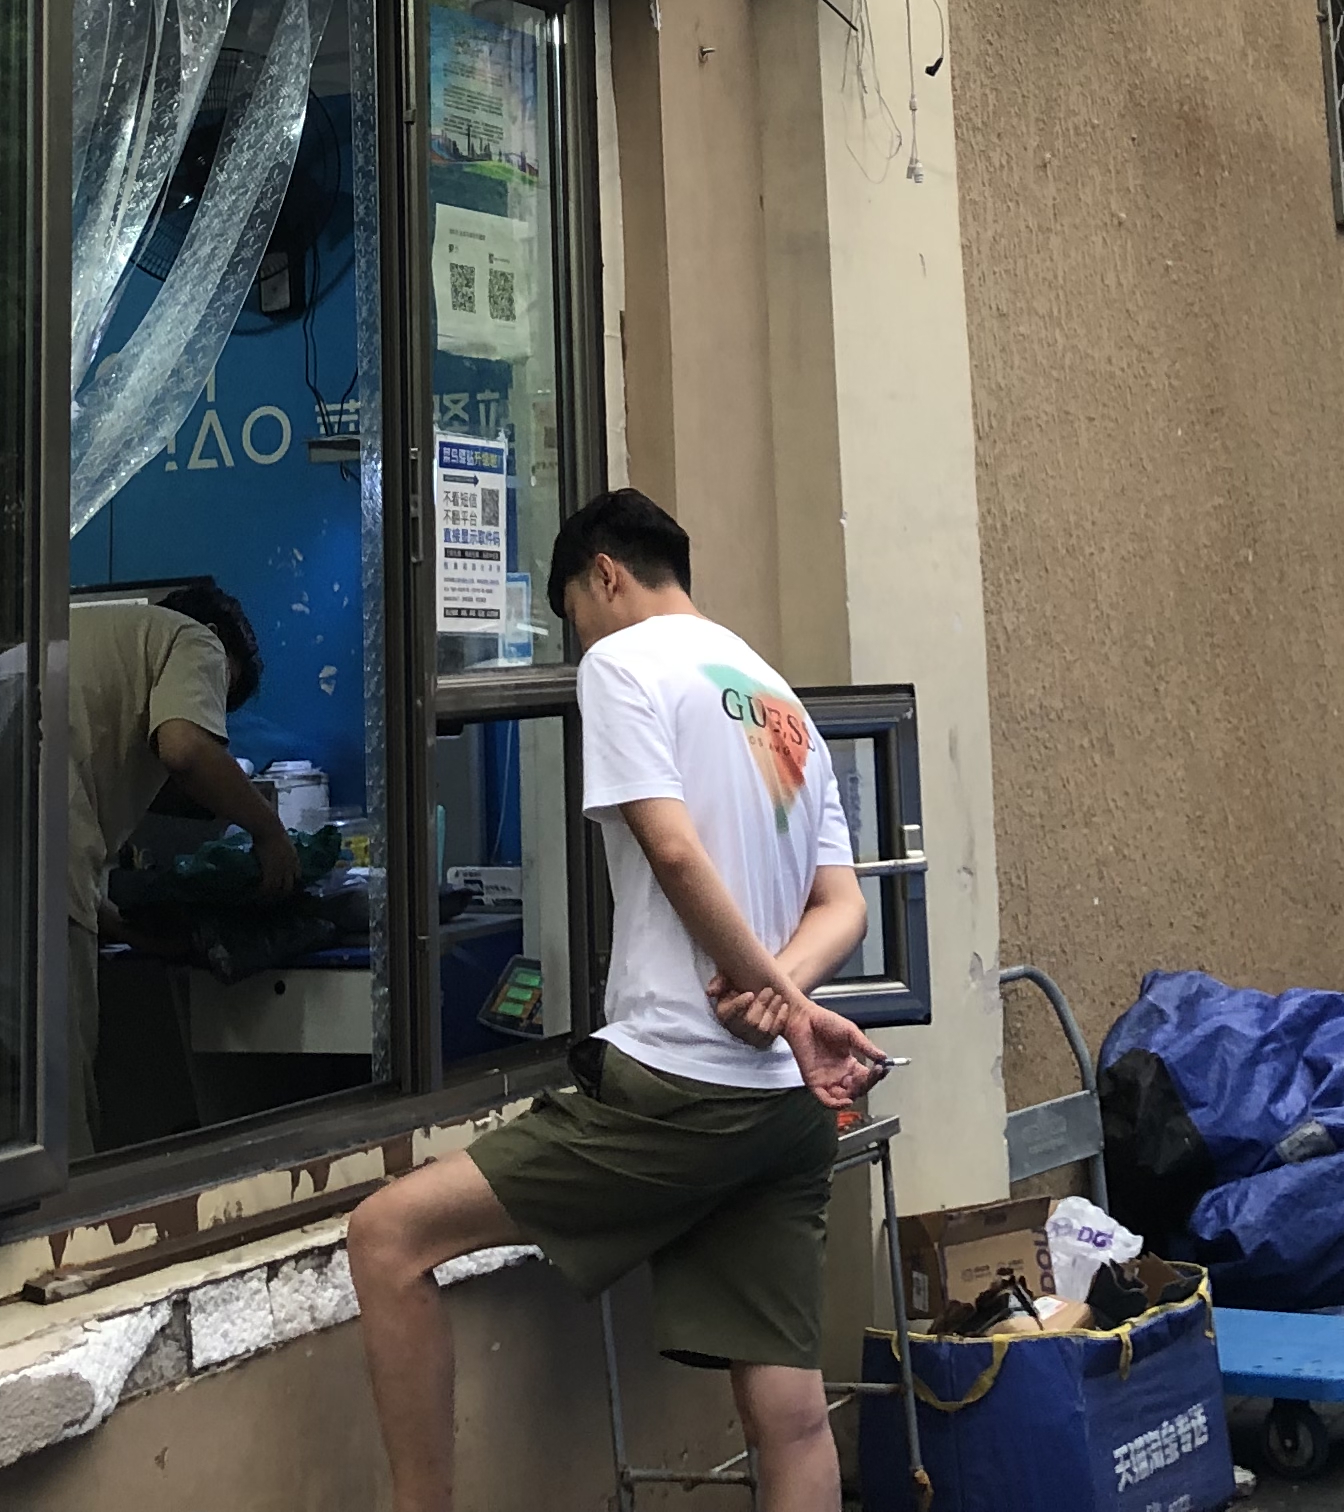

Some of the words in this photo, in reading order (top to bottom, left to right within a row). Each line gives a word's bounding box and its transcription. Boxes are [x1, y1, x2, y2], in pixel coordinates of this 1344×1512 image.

[443, 490, 478, 509] 不看短信
[443, 527, 501, 548] 直接显示取件码
